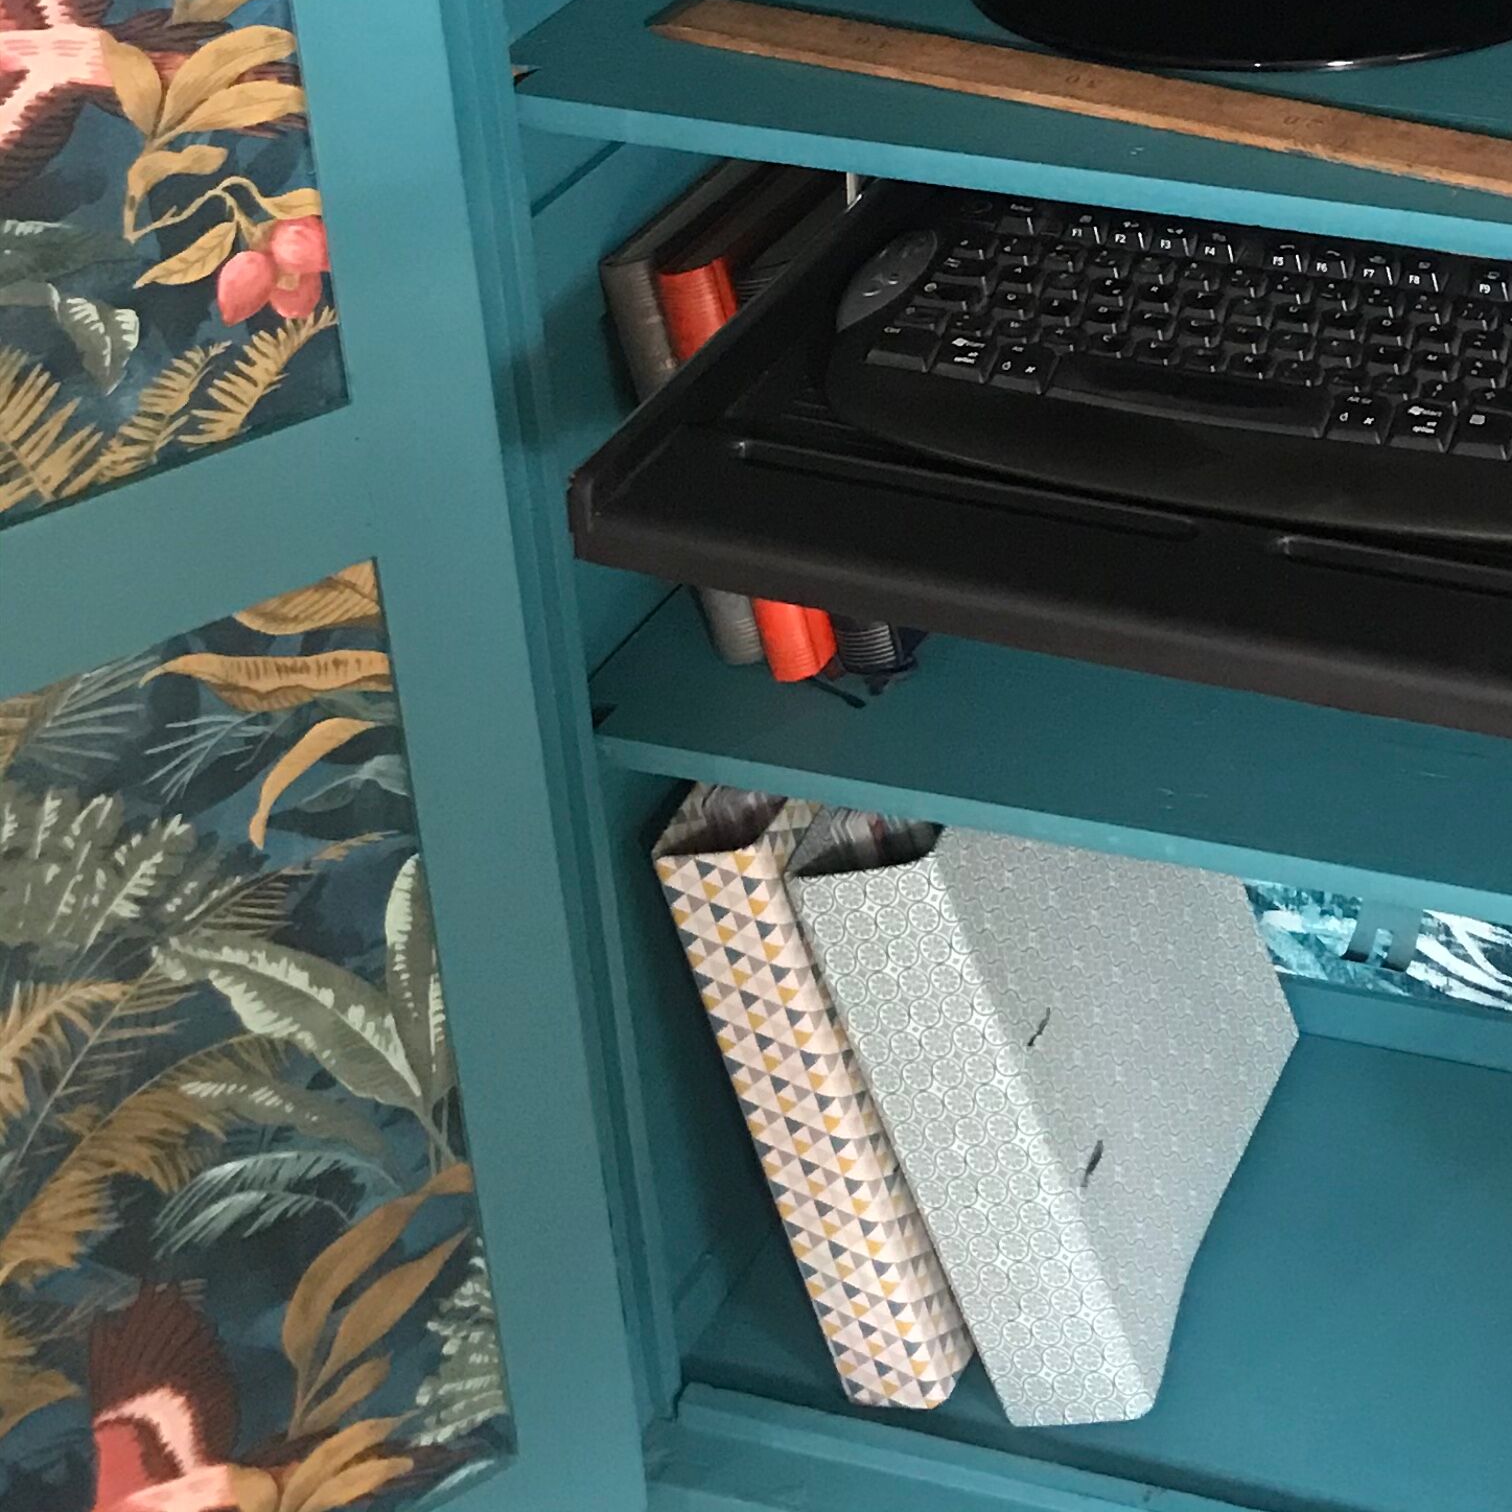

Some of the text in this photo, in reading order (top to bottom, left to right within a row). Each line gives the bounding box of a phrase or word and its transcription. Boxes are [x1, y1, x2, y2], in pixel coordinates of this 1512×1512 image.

[1072, 228, 1083, 237] F1
[1115, 234, 1126, 243] F2
[1160, 239, 1172, 249] F3
[1205, 246, 1215, 256] F4
[1273, 256, 1284, 266] F5
[1317, 262, 1328, 272] F6
[1363, 268, 1375, 278] F7
[1409, 275, 1420, 284] F8
[1479, 283, 1491, 294] F9
